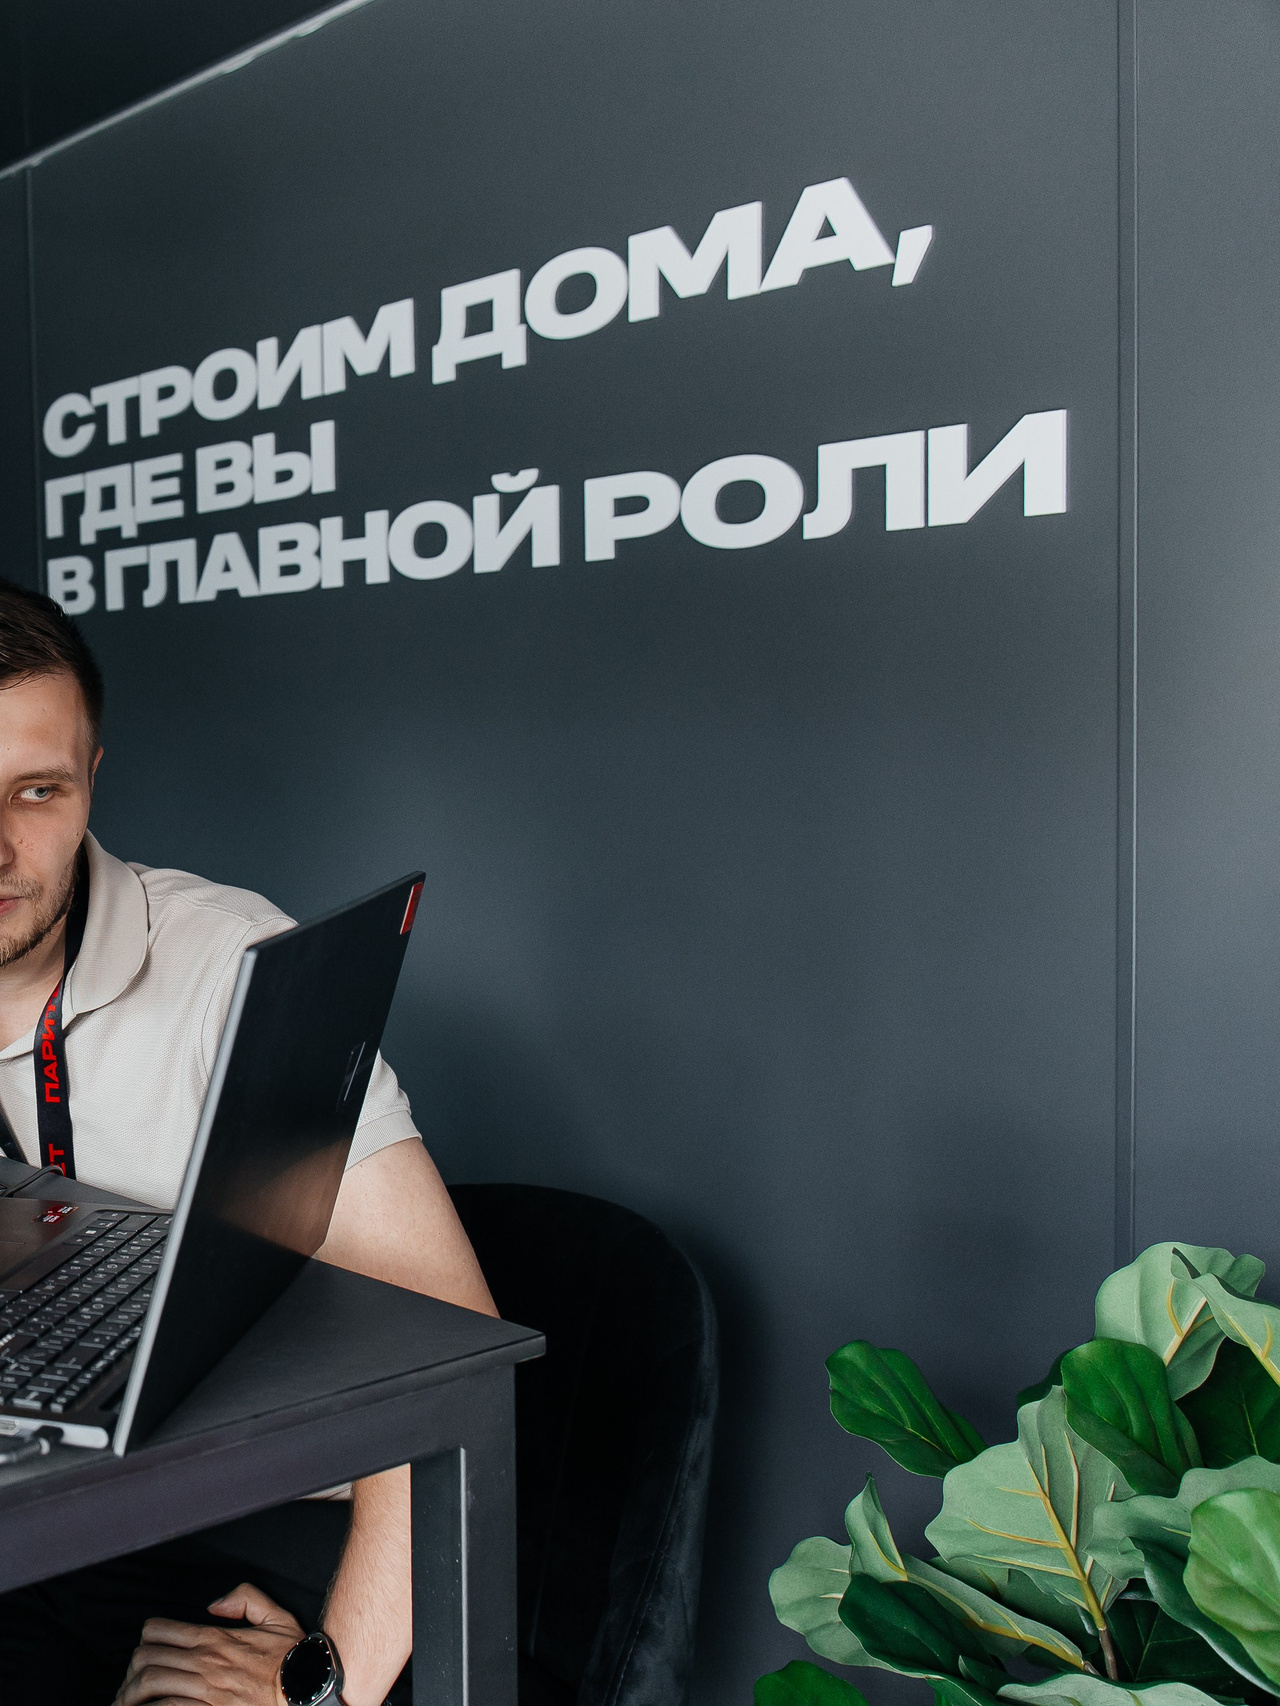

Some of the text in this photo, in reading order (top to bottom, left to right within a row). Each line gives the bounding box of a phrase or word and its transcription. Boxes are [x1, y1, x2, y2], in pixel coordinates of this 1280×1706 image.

[43, 176, 934, 457] СТРОИМ ДОМА,
[45, 419, 336, 545] ГДЕ ВЫ
[47, 408, 1068, 616] В ГЛАВНОЙ РОЛИ
